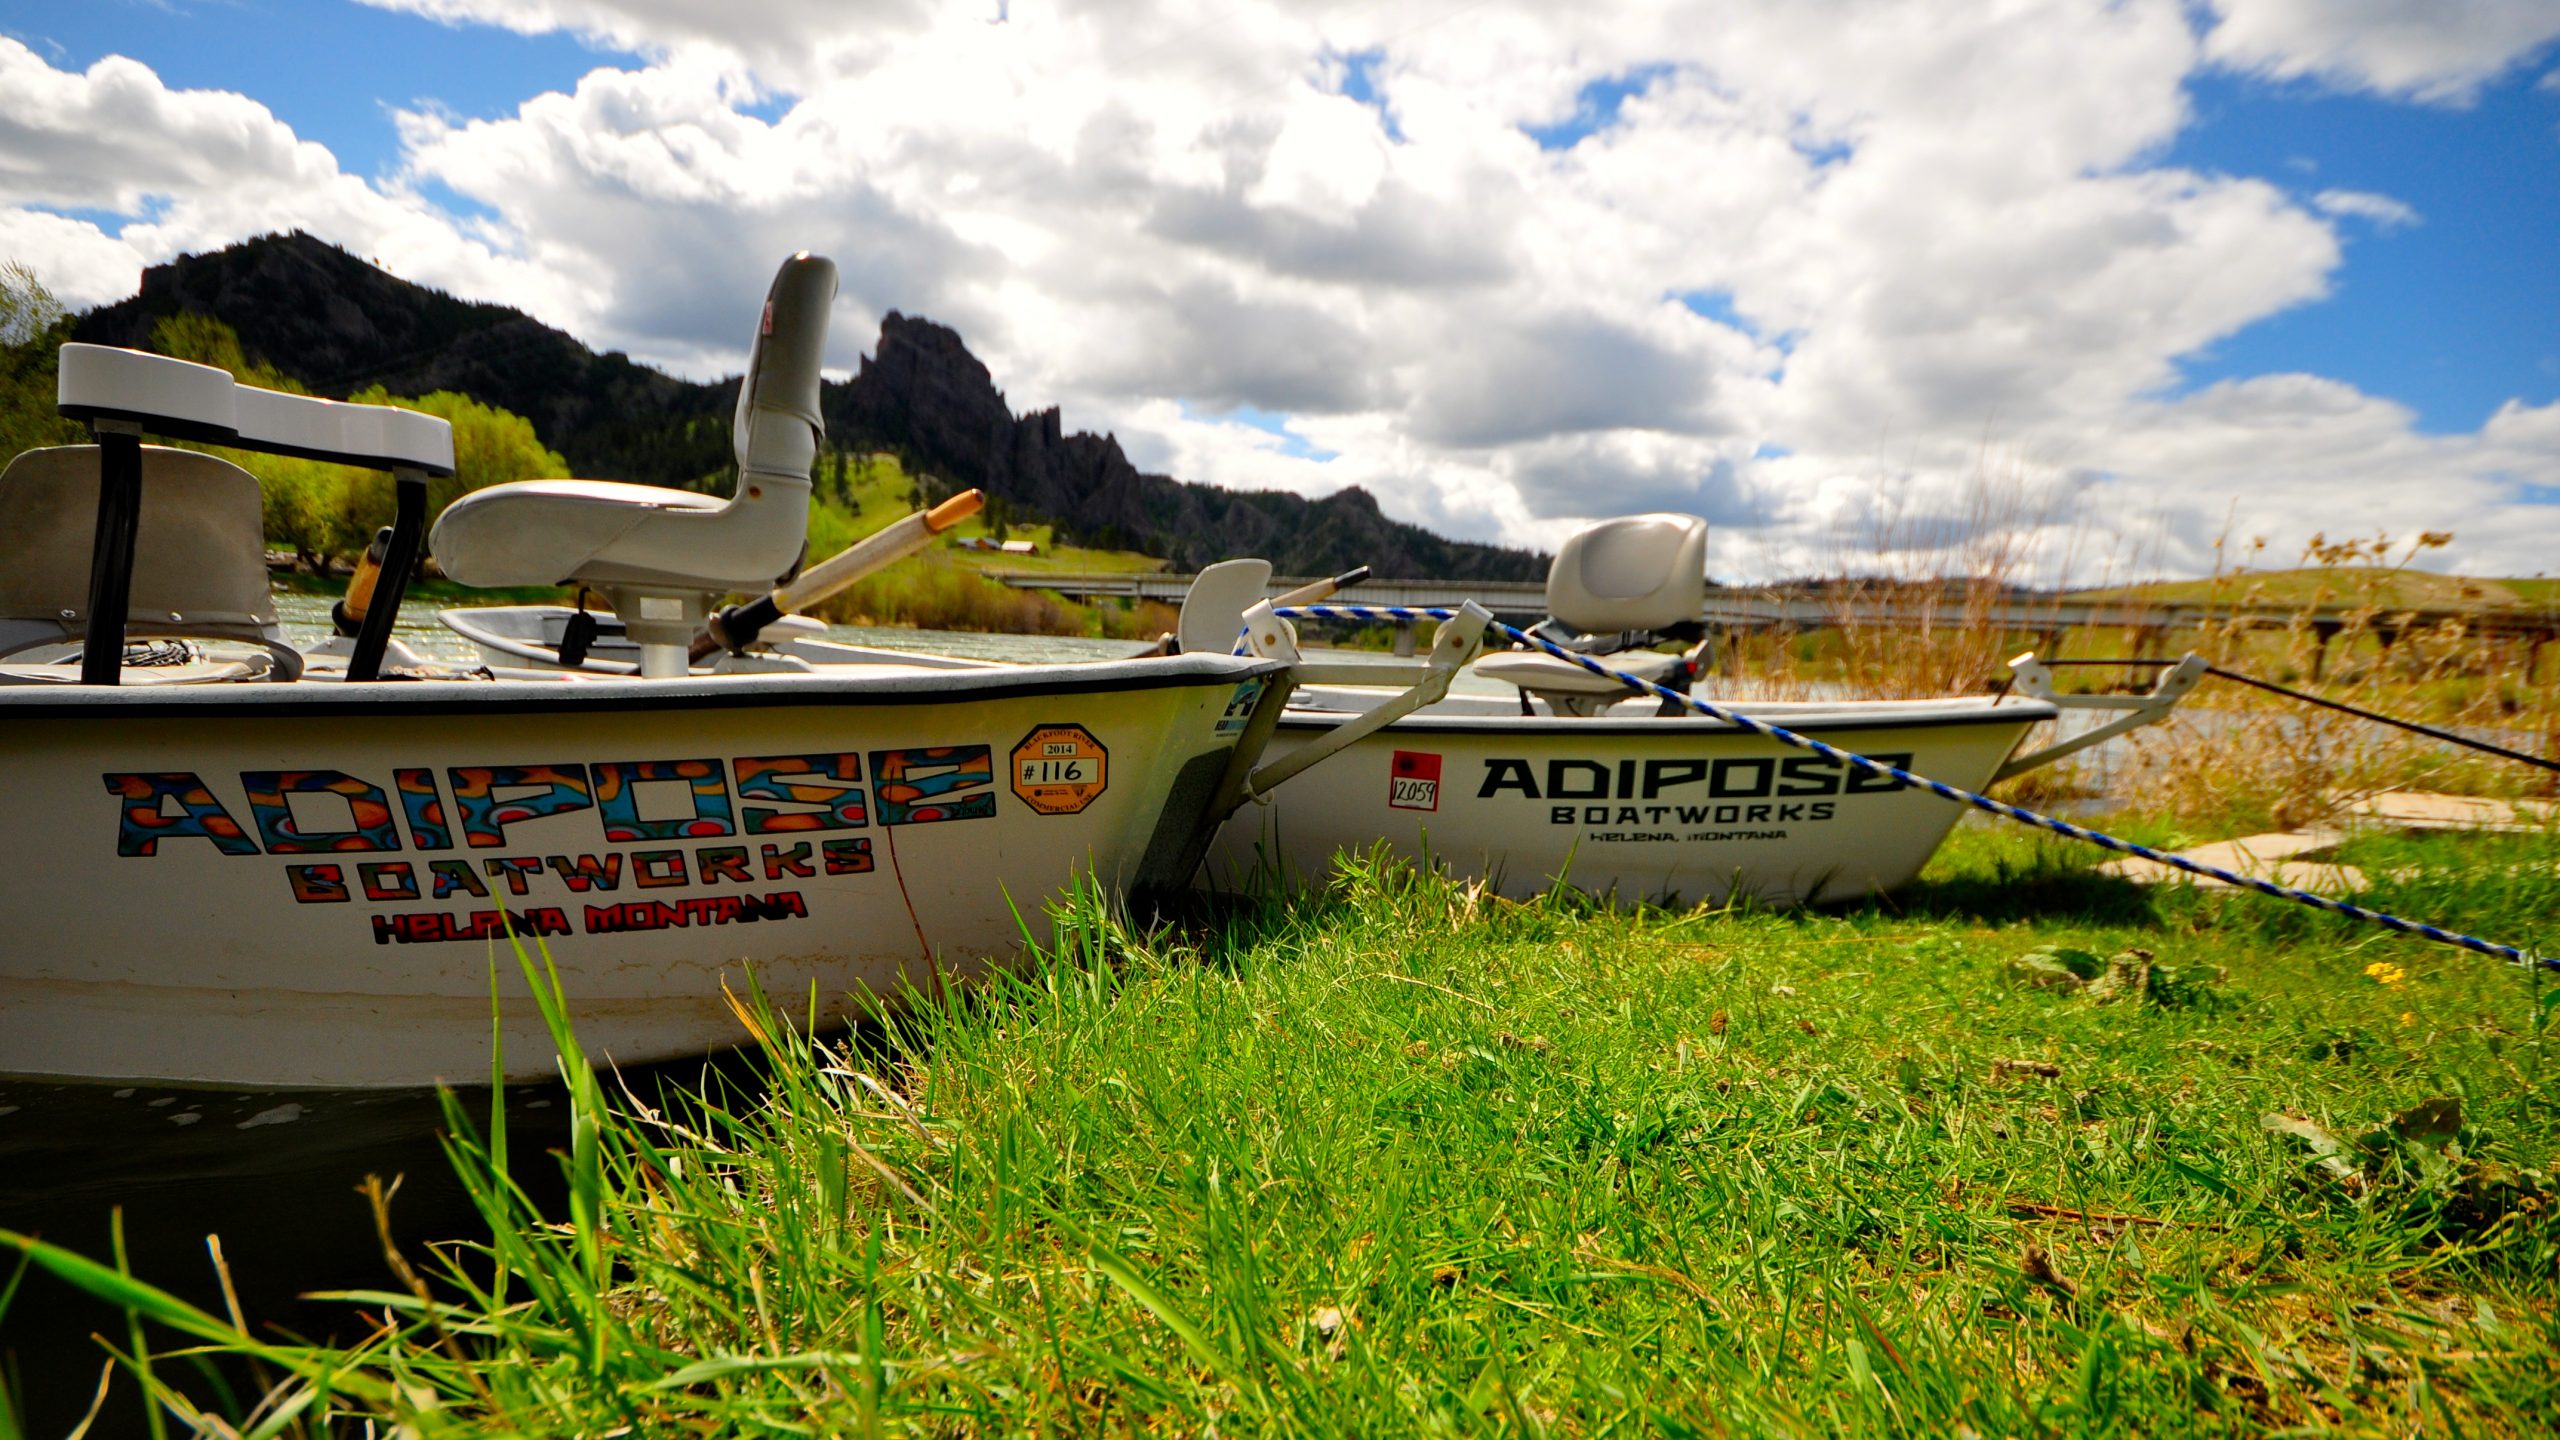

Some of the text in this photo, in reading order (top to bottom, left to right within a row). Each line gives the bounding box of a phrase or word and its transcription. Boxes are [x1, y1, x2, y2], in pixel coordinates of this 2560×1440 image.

[1024, 730, 1096, 750] BLACKFOOT RIVER
[1047, 744, 1073, 755] 2014
[1477, 753, 1914, 800] ADIPOSE
[102, 743, 996, 857] ADIPOSE
[1392, 780, 1436, 803] 12059
[1026, 795, 1078, 812] COMMERCIAL
[1551, 802, 1836, 825] BOATWORKS
[285, 837, 875, 904] BOATWORKS
[371, 891, 808, 945] HELENA MONTANA
